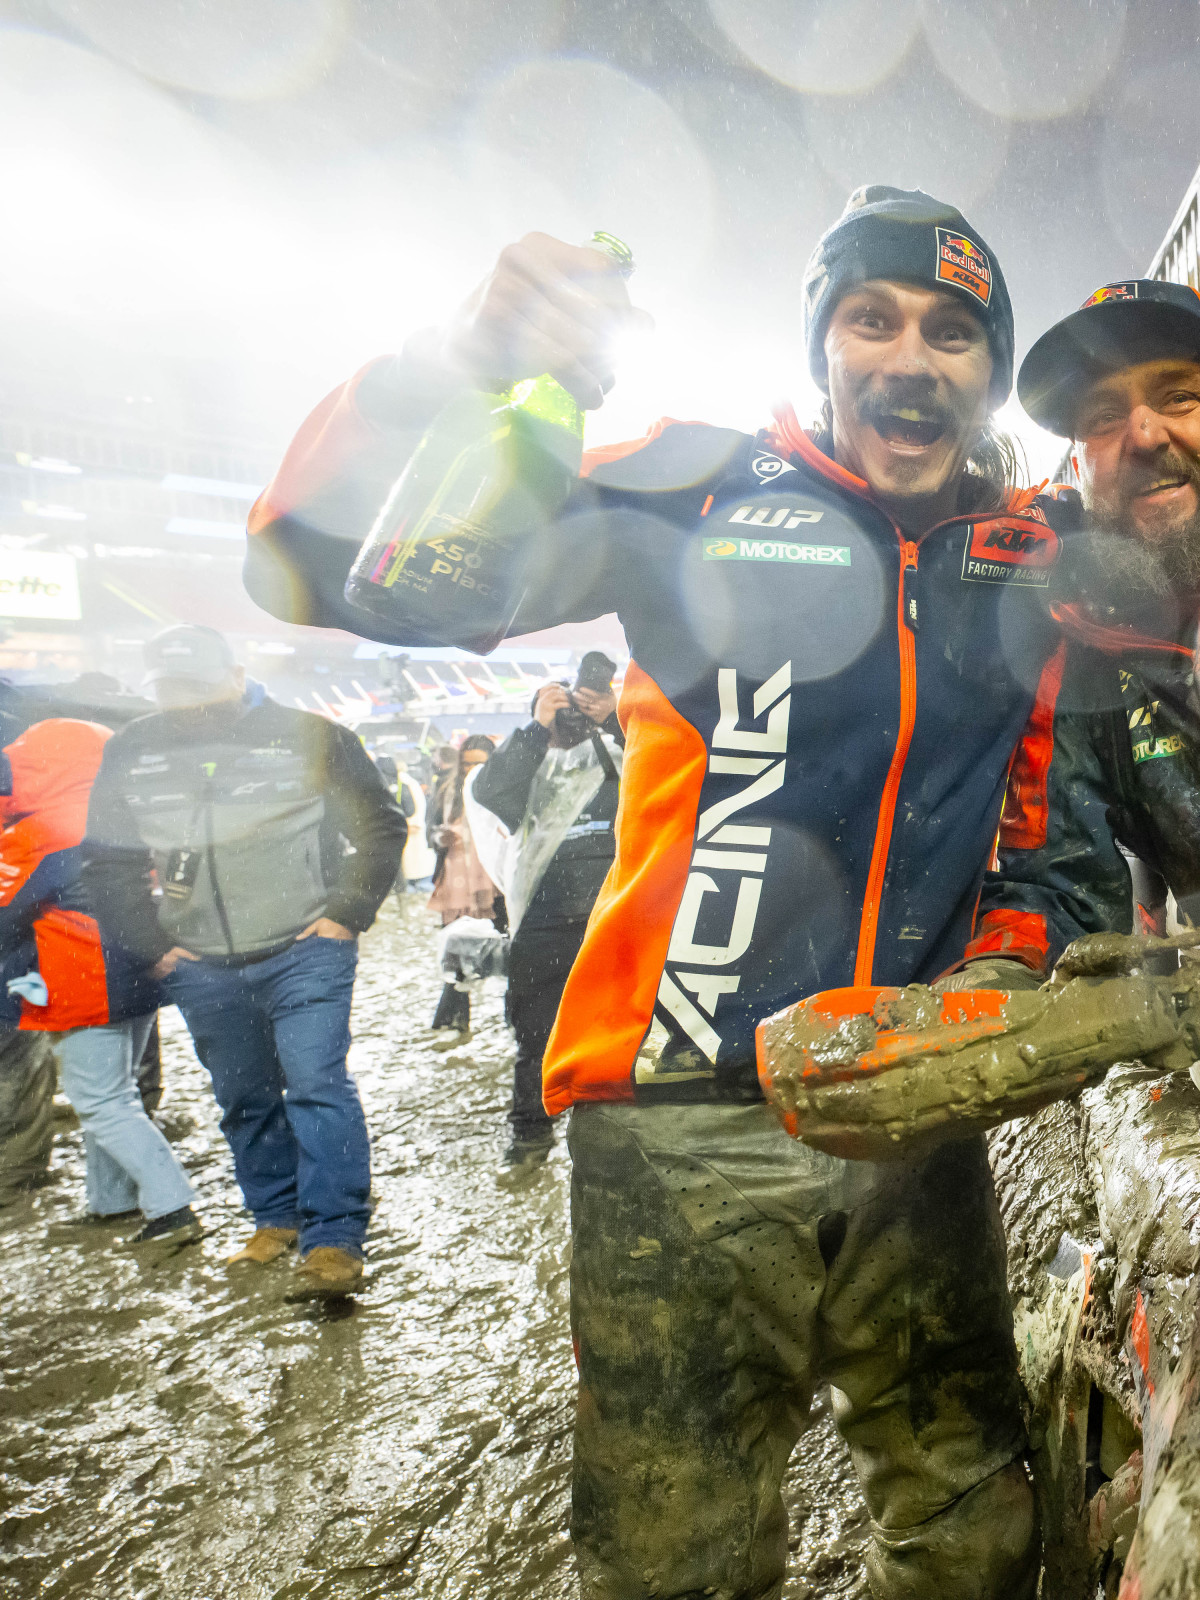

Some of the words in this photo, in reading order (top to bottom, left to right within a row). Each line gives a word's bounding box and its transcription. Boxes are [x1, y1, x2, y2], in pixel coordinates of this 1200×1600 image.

[941, 245, 967, 269] Red
[967, 257, 989, 283] Bull
[952, 271, 980, 291] KTM
[728, 506, 824, 529] WP
[739, 541, 846, 563] MOTOREX
[983, 527, 1049, 554] KTM
[426, 538, 483, 569] 450
[968, 561, 1012, 578] FACTORY
[1013, 568, 1048, 582] RACING
[635, 660, 792, 1085] RACING
